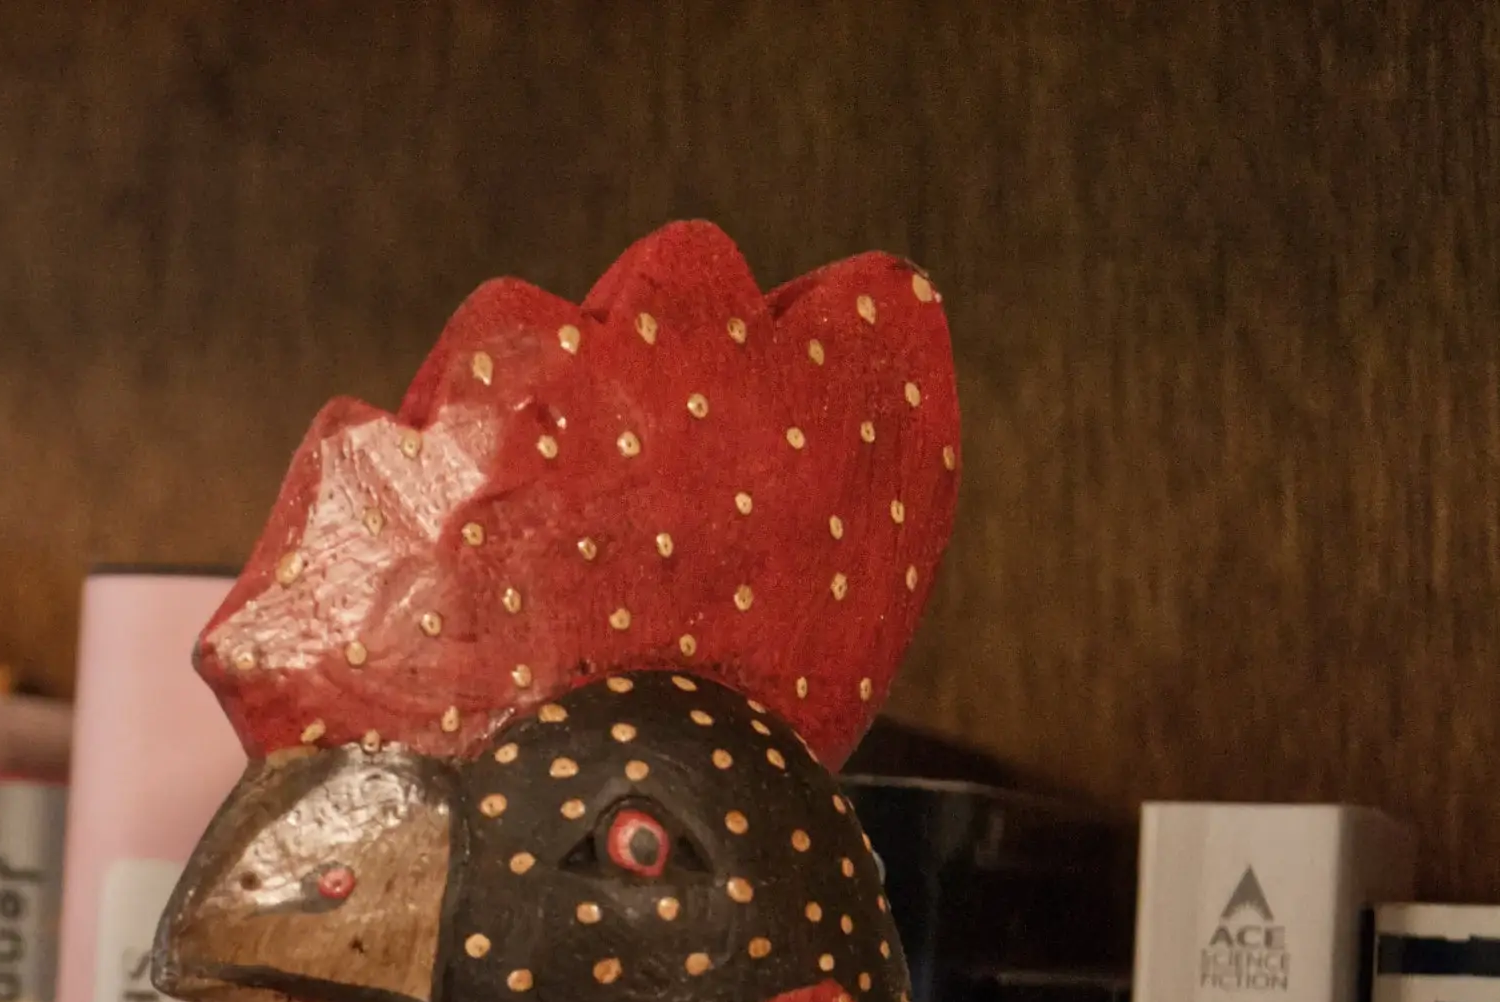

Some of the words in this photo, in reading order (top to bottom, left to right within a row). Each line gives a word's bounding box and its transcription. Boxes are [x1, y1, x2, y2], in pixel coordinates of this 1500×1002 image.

[1208, 923, 1286, 951] ACE
[1200, 948, 1291, 975] SCIENCE
[1199, 969, 1288, 993] FICTION
